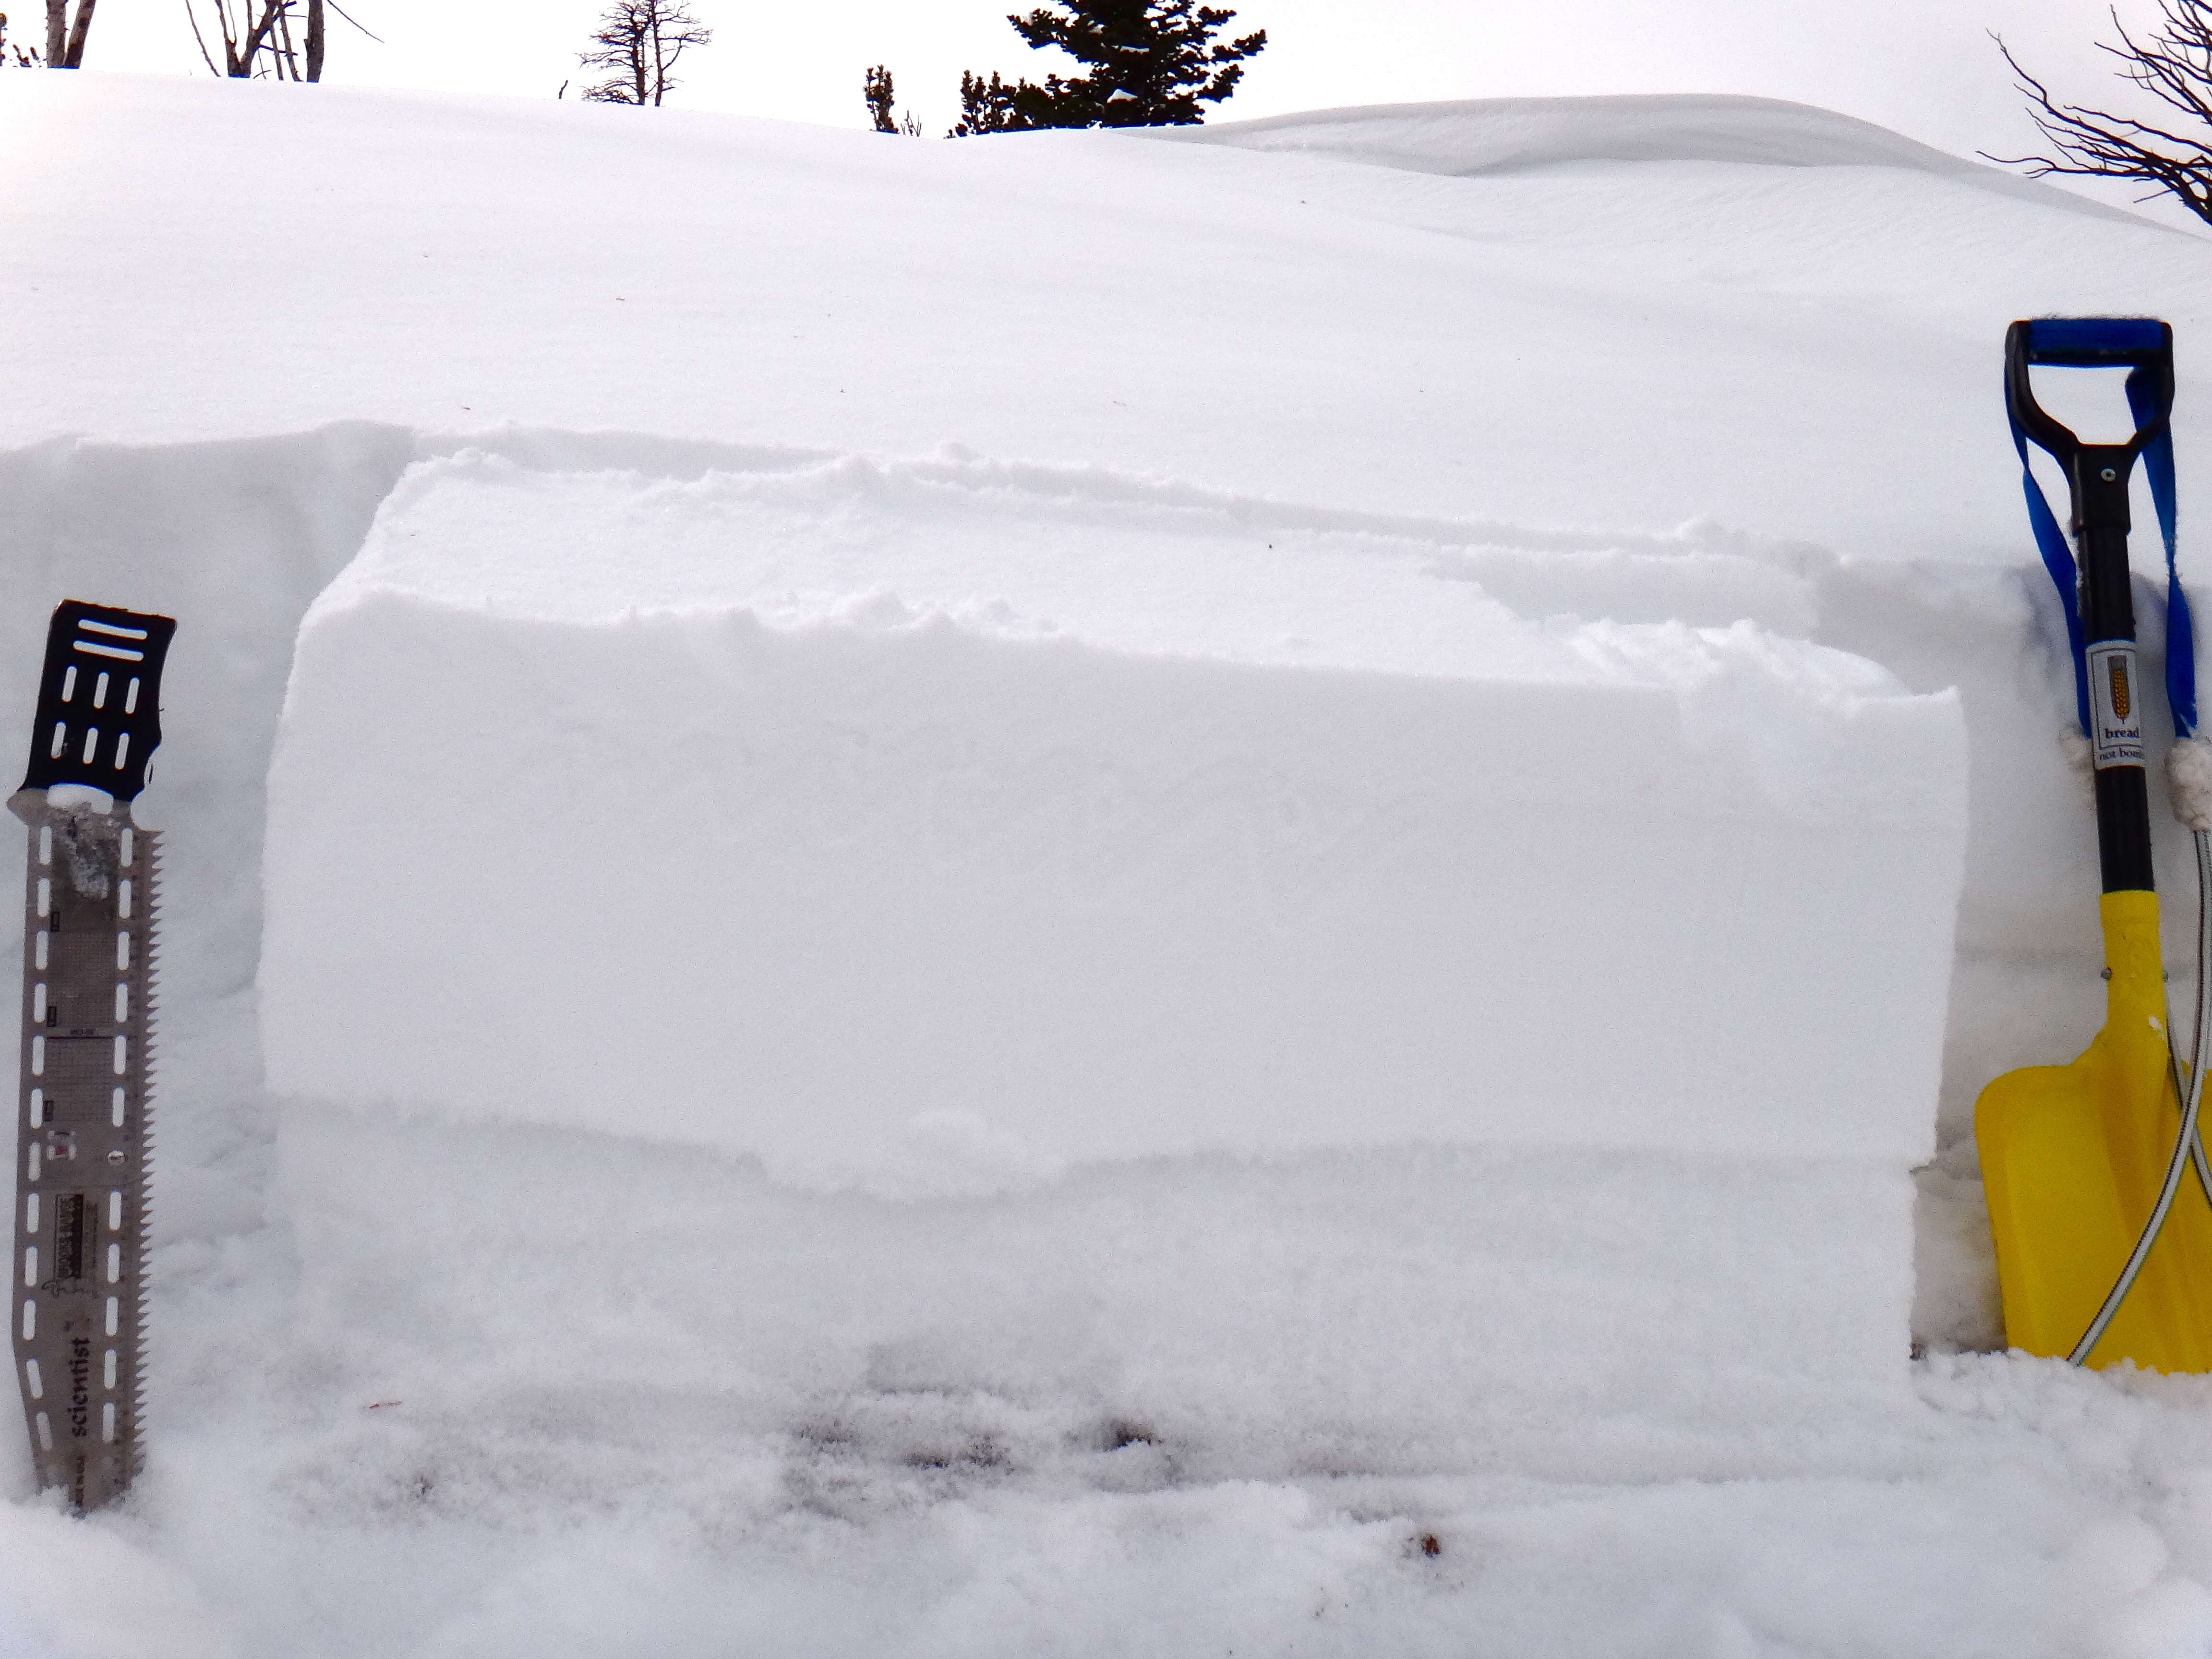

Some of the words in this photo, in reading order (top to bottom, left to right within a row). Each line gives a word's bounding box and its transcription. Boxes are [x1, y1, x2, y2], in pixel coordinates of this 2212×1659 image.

[2104, 727, 2139, 739] bread
[2100, 750, 2116, 760] not
[68, 1336, 90, 1438] scientist
